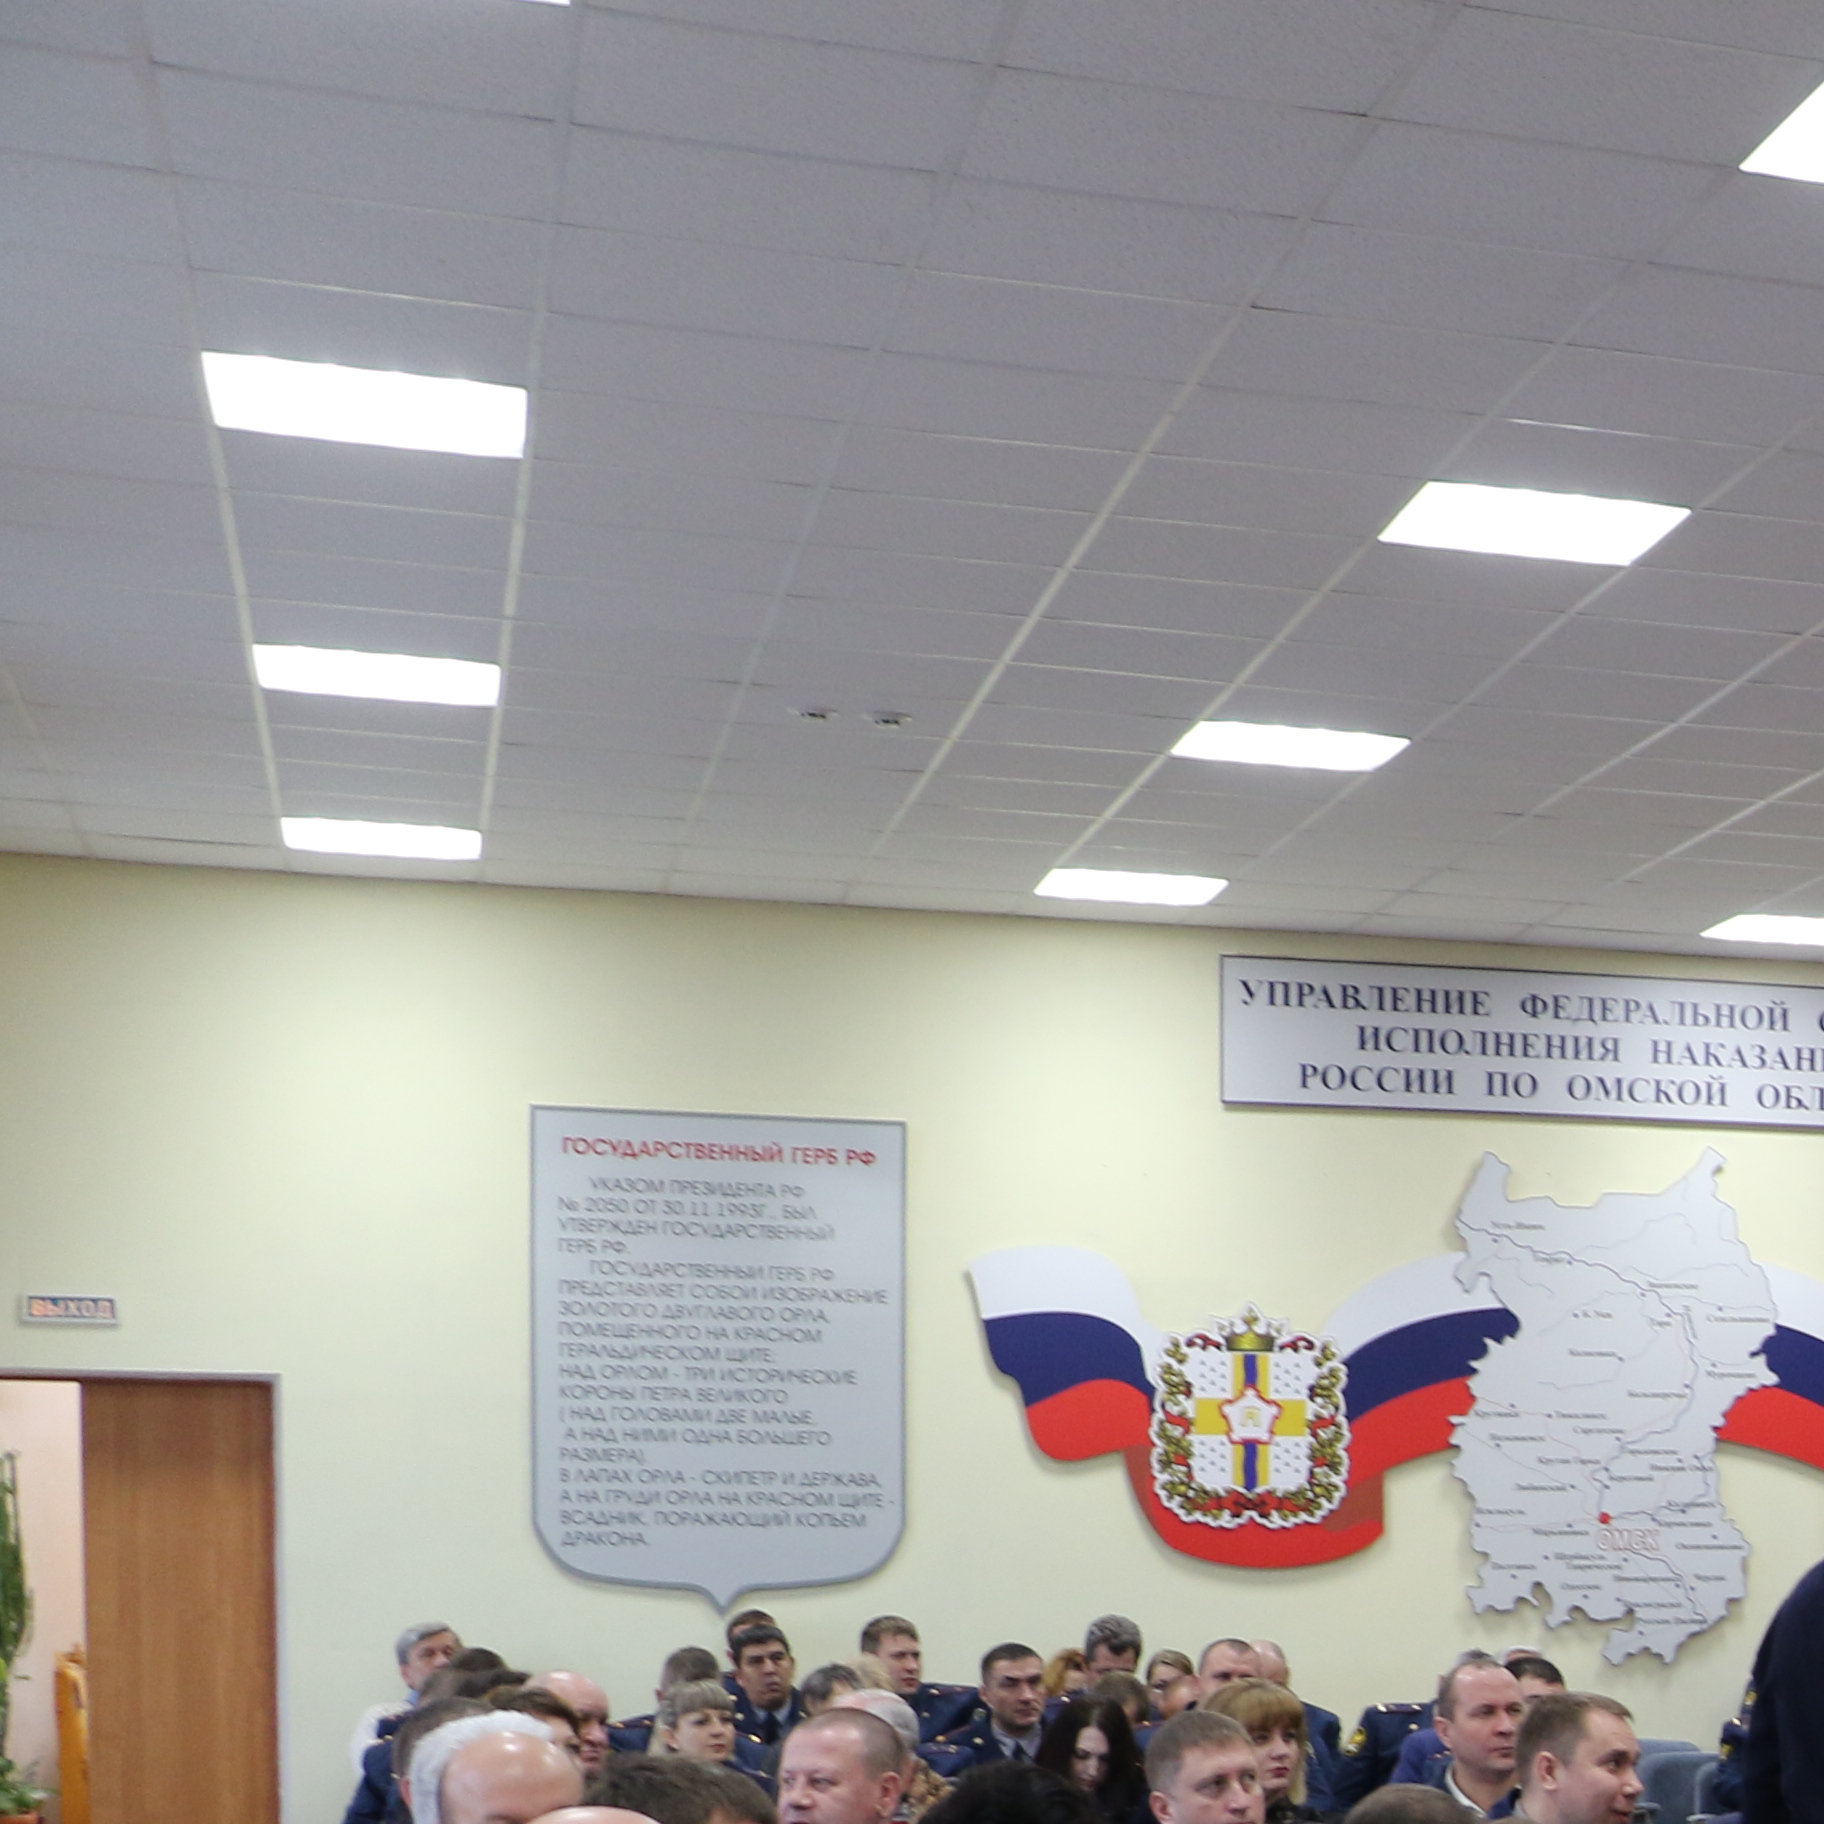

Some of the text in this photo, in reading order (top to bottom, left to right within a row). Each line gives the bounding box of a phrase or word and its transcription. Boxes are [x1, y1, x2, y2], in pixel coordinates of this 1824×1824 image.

[1238, 979, 1492, 1017] УПРАВЛЕНИЕ
[1519, 991, 1791, 1033] ФЕДЕРАЛЬНОЙ
[1356, 1024, 1620, 1063] ИСПОЛНЕНИЯ
[1299, 1062, 1456, 1096] РОССИИ
[1485, 1072, 1538, 1099] ПО
[1567, 1074, 1728, 1108] ОМСКОЙ
[561, 1138, 877, 1166] ГОСУДАРСТВЕННЫЙ ГЕРБ РФ
[1596, 1527, 1661, 1551] ОМСК
